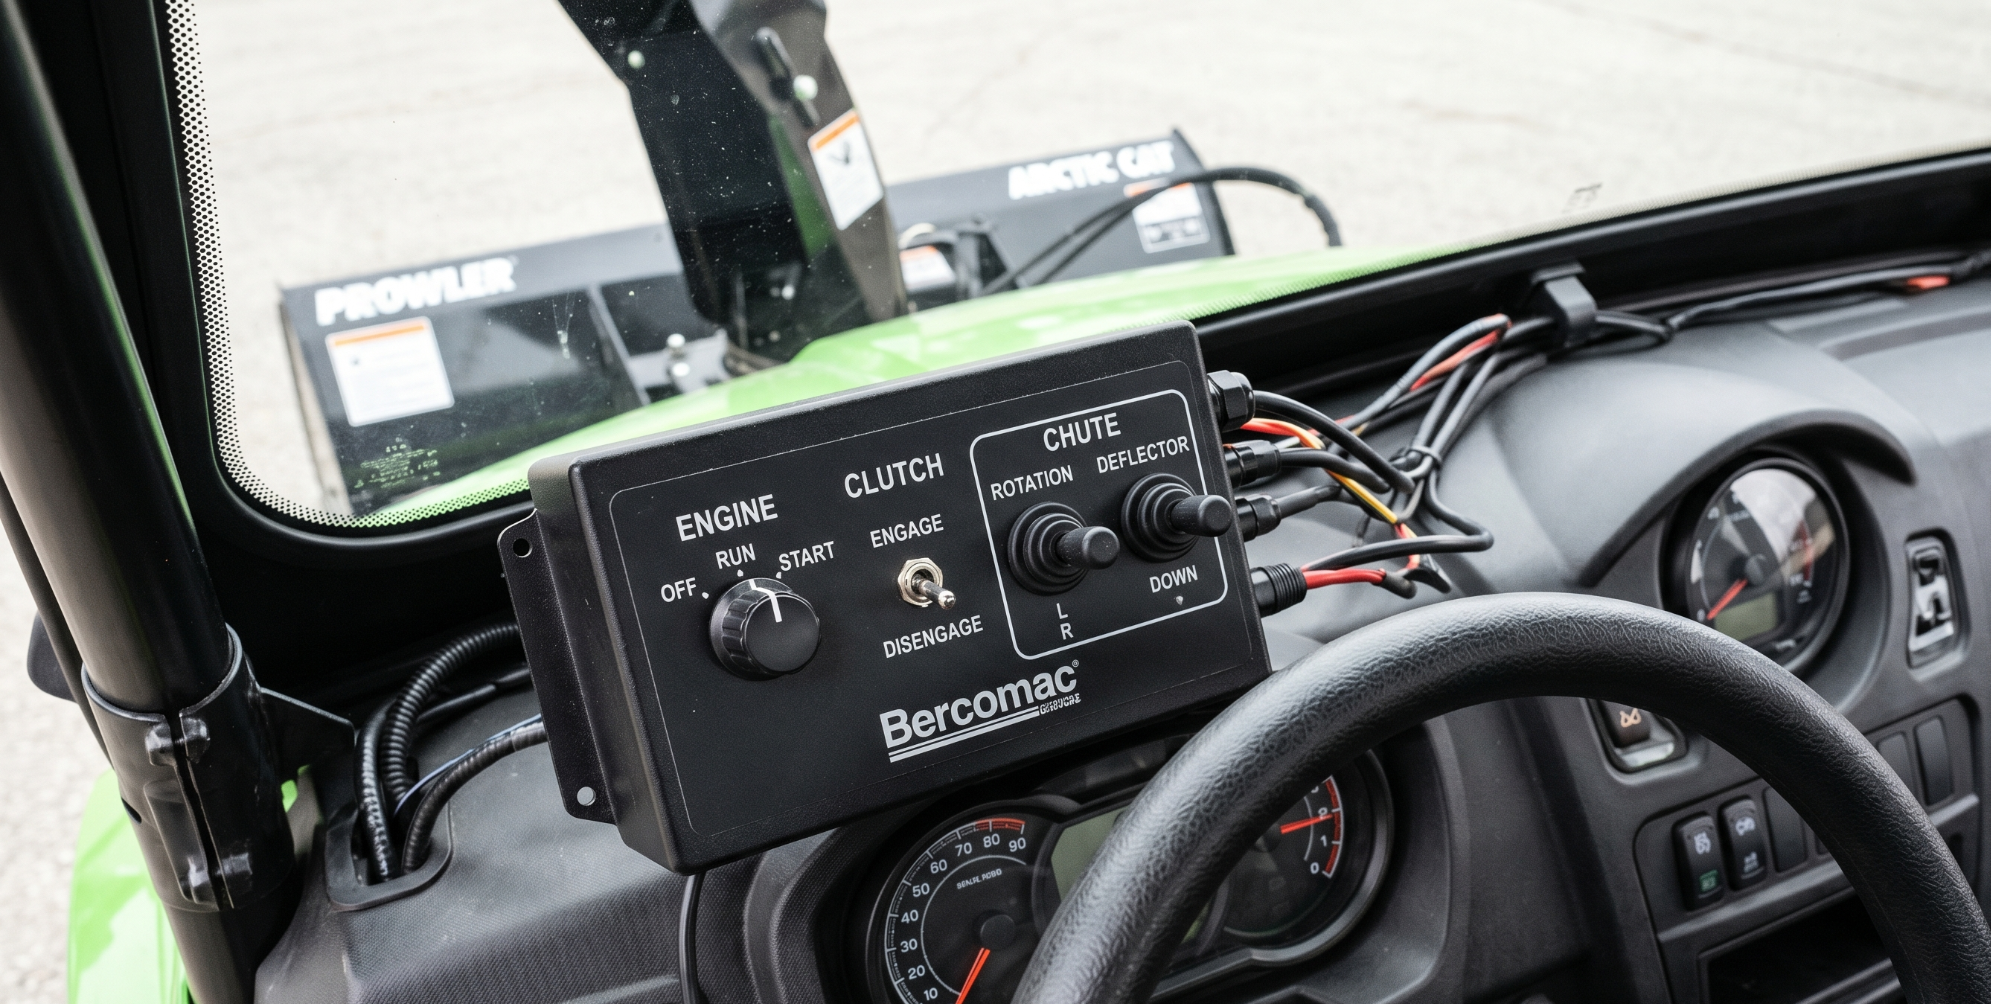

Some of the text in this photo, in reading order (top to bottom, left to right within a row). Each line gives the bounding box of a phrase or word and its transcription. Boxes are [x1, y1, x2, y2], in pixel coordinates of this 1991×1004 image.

[1008, 140, 1175, 200] ARCTIC CAT
[315, 258, 515, 326] PROWLER
[1043, 412, 1122, 452] CHUTE
[1096, 435, 1190, 474] DEFLECTOR
[844, 452, 945, 499] CLUTCH
[990, 464, 1074, 501] ROTATION
[675, 493, 779, 542] ENGINE
[869, 513, 944, 549] ENGAGE
[715, 543, 756, 570] RUN
[778, 540, 834, 572] START
[660, 577, 697, 603] OFF
[1149, 564, 1198, 594] DOWN
[1056, 602, 1069, 620] L
[882, 614, 984, 659] DISENGAGE
[1060, 622, 1074, 640] R
[954, 842, 973, 857] 70
[982, 833, 1001, 848] 80
[1008, 837, 1027, 853] 90
[1320, 834, 1328, 847] 1
[929, 859, 948, 874] 60
[1309, 861, 1320, 875] 0
[912, 882, 930, 898] 50
[901, 909, 919, 924] 40
[900, 938, 918, 953] 30
[907, 964, 926, 980] 20
[923, 987, 938, 1001] 10
